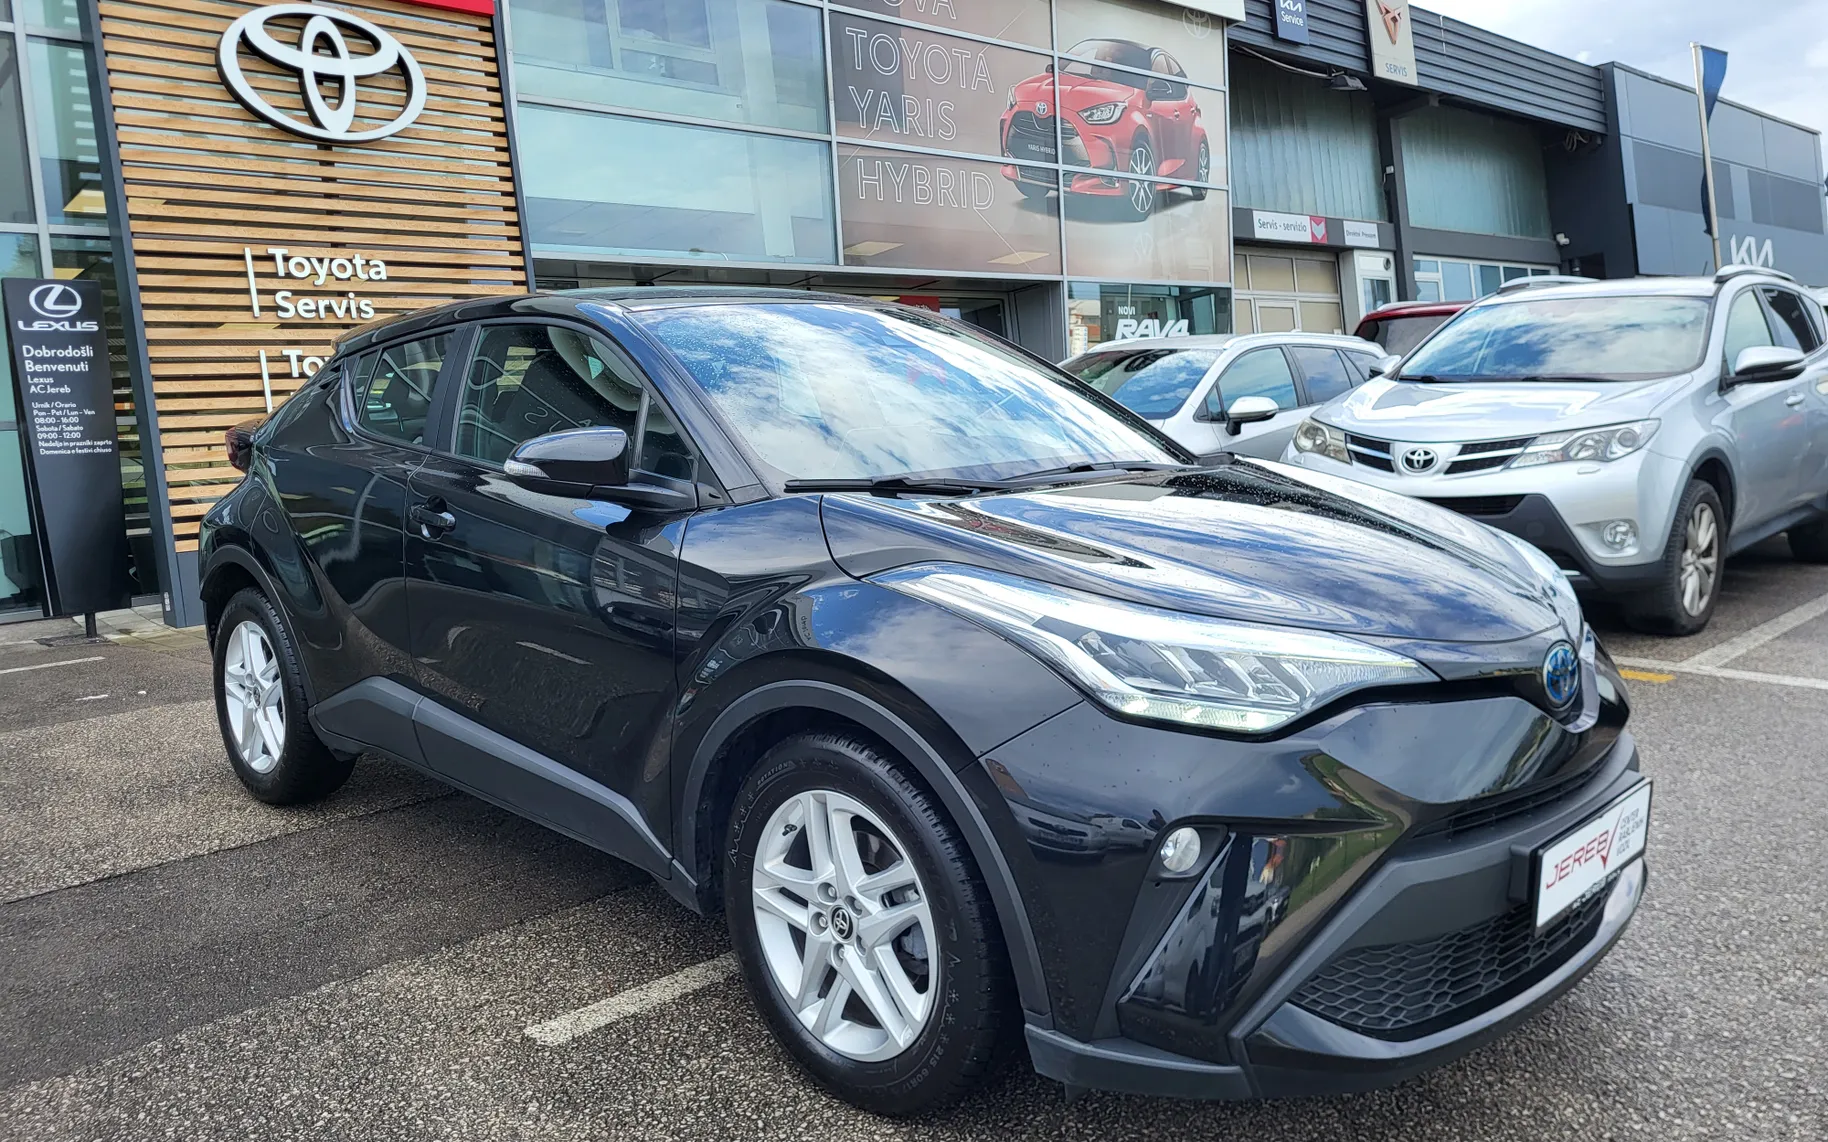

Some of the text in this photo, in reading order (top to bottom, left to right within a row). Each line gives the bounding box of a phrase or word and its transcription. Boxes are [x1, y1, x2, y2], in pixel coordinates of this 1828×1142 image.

[1281, 10, 1304, 27] Service
[846, 27, 994, 94] TOYOTA
[1385, 62, 1408, 77] SERVIS
[848, 86, 957, 140] YARIS
[857, 158, 995, 210] HYBRID
[1257, 219, 1278, 230] Servis
[1283, 220, 1307, 232] servizio
[267, 248, 388, 287] Toyota
[274, 291, 375, 319] Servis
[1118, 306, 1136, 316] NOVI
[17, 320, 99, 332] LEXUS
[1115, 318, 1190, 340] RAV4
[22, 345, 94, 357] Dobrodošli
[24, 360, 89, 372] Benvenuti
[282, 349, 330, 378] To
[27, 375, 54, 383] Lexus
[29, 385, 71, 394] AC Jereb
[31, 401, 50, 409] Urnik
[62, 431, 81, 439] 12:00
[1546, 830, 1609, 889] JEREB
